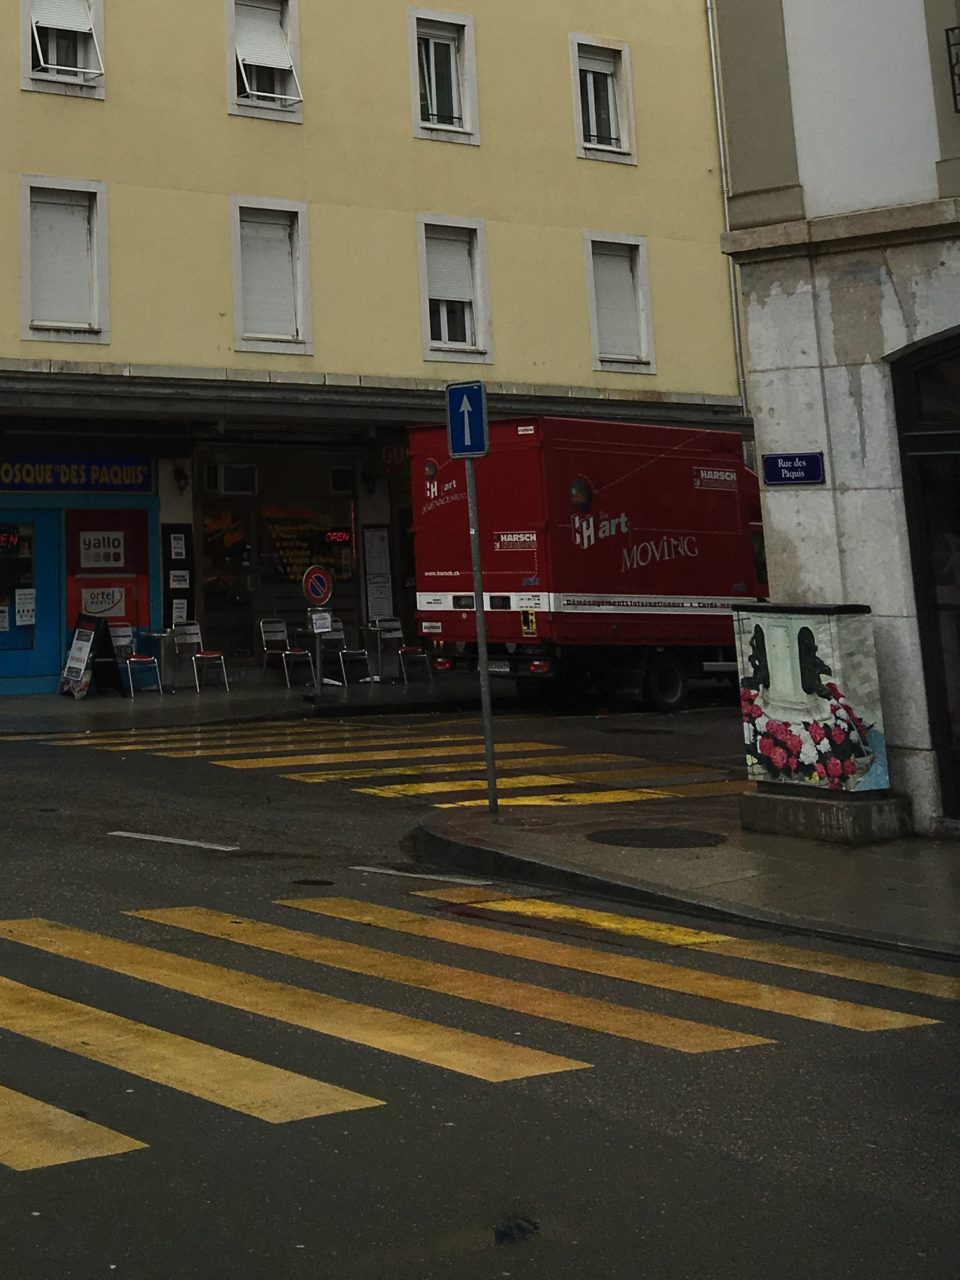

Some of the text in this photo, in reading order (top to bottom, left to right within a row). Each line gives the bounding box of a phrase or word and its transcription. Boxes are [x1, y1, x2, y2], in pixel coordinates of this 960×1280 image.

[777, 457, 807, 468] Rue des
[700, 469, 737, 481] HARSCH
[325, 532, 350, 542] OPEN
[500, 533, 537, 542] HARSCH
[82, 536, 122, 551] yallo
[90, 590, 115, 600] ortel
